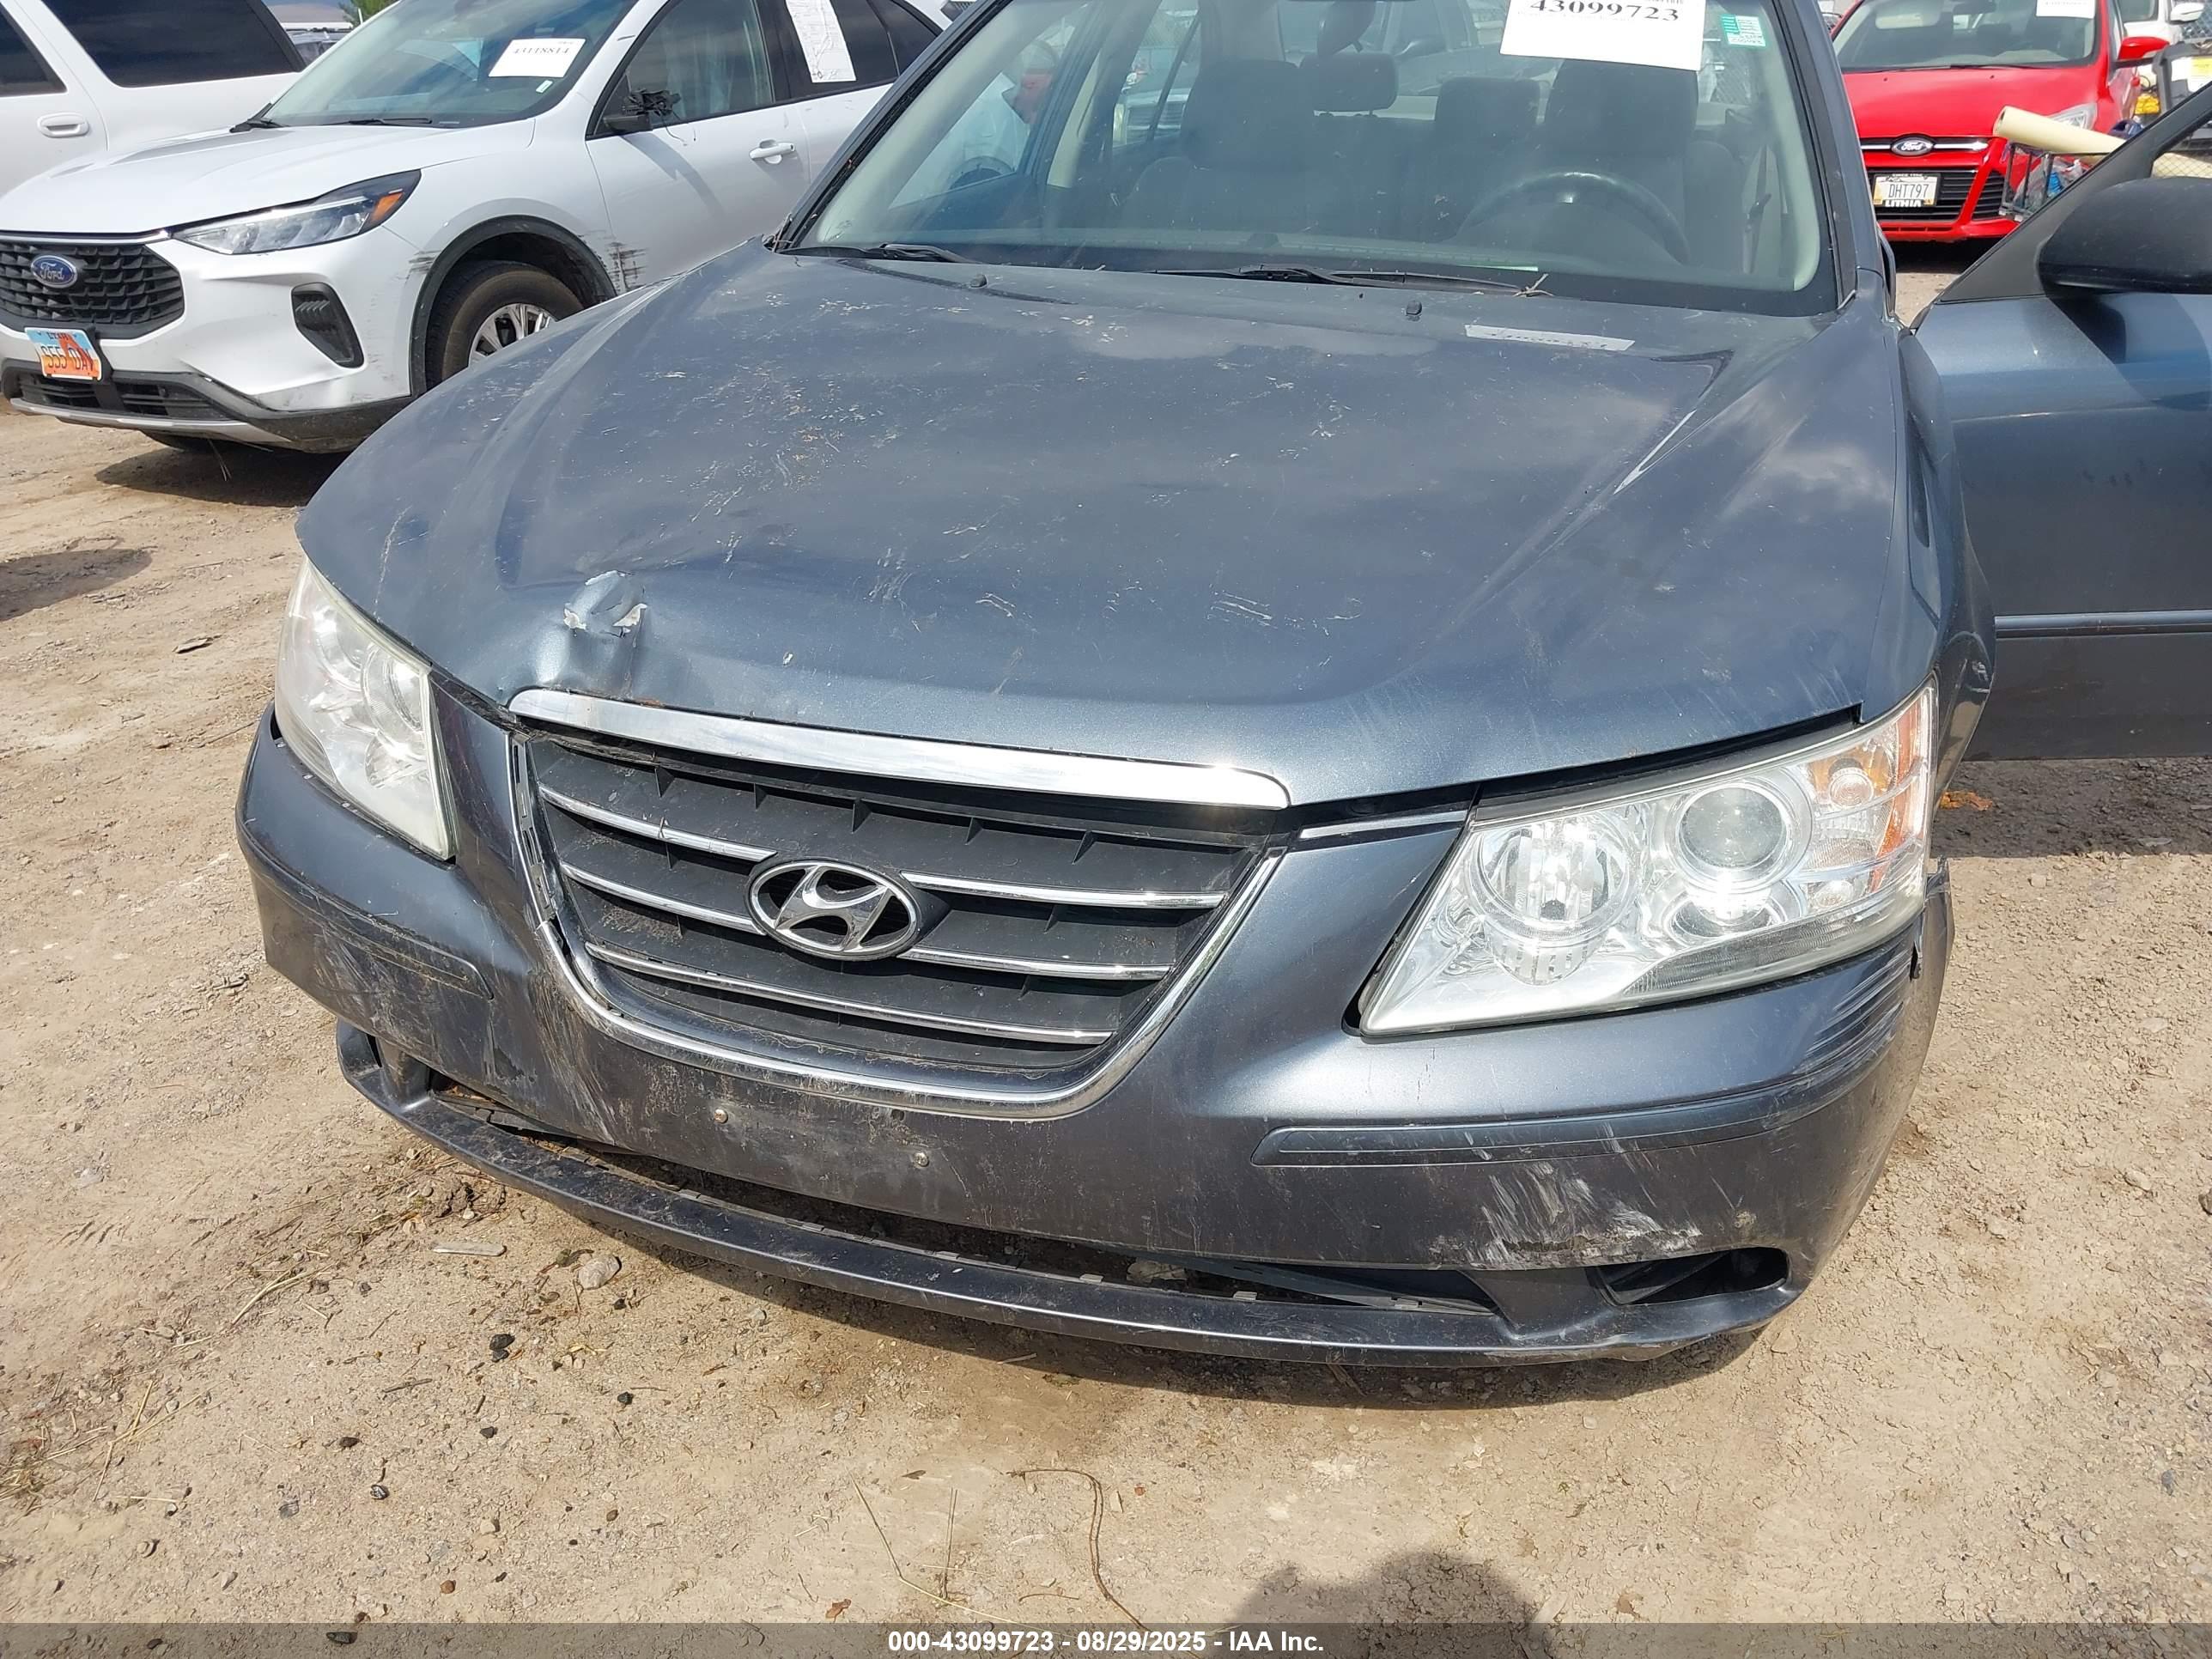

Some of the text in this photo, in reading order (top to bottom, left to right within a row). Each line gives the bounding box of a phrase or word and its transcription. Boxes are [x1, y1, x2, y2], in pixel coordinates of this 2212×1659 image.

[1530, 0, 1679, 21] 43099723
[1888, 183, 1929, 198] DHT797
[1885, 199, 1922, 208] LITHIA
[40, 261, 65, 281] Ford
